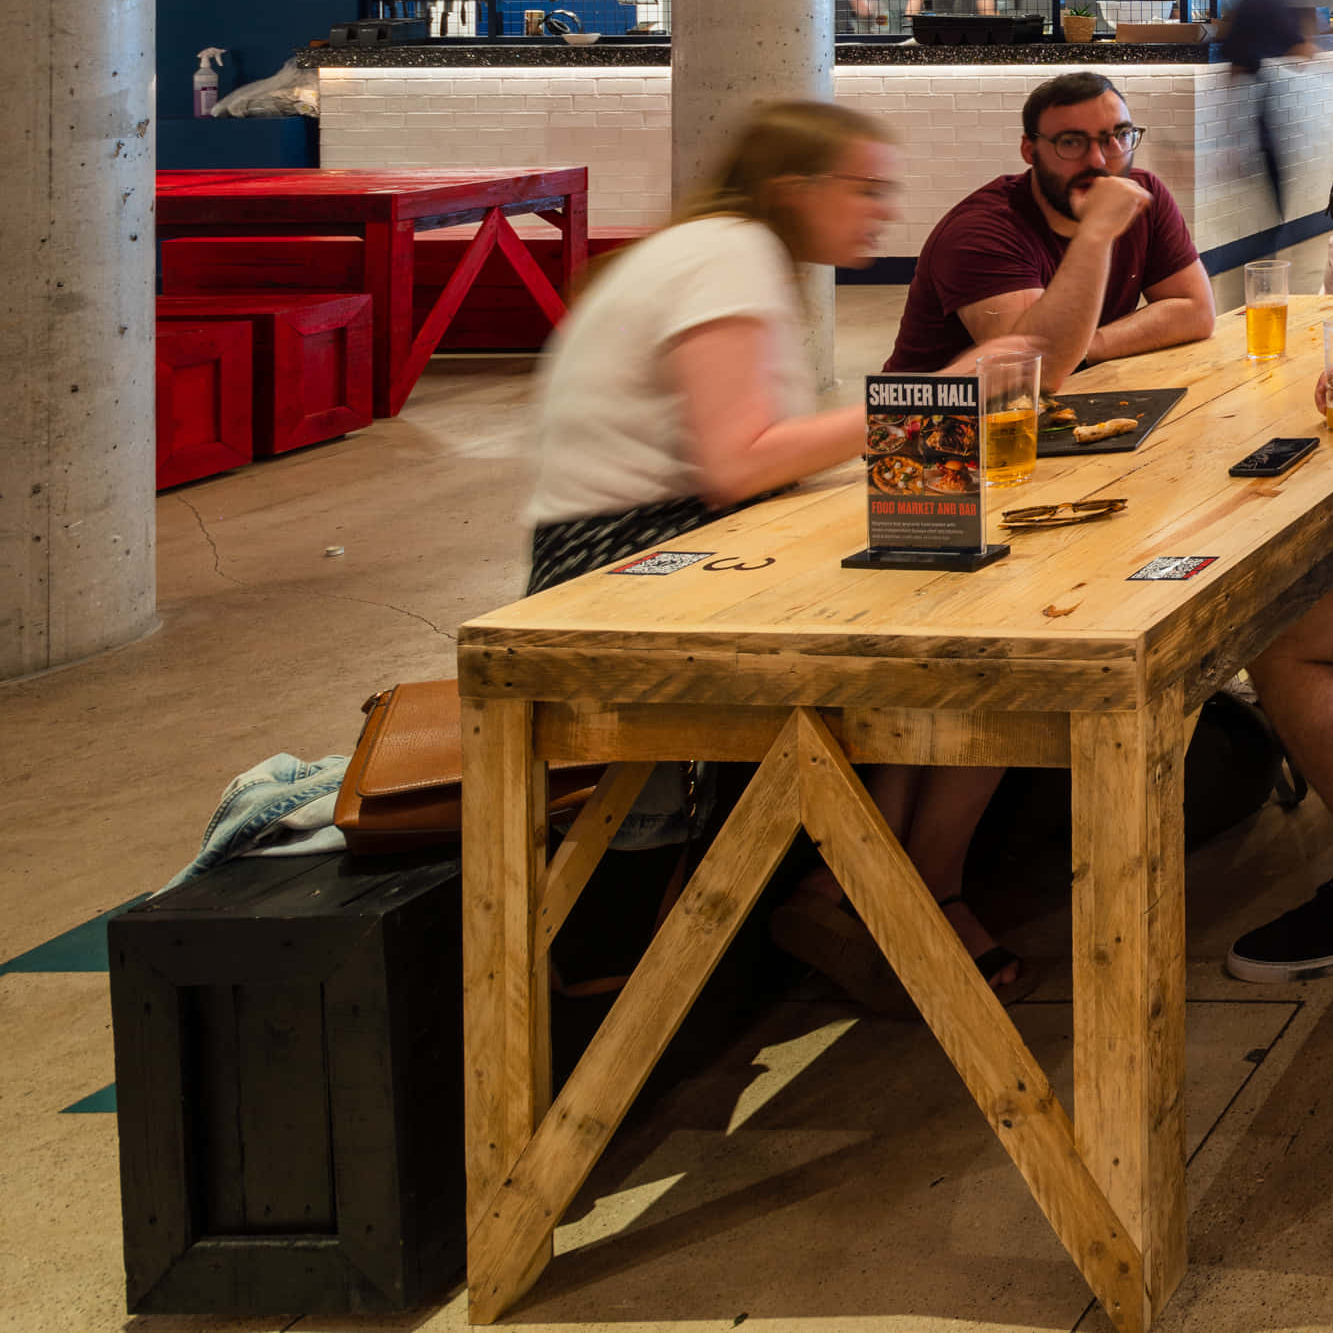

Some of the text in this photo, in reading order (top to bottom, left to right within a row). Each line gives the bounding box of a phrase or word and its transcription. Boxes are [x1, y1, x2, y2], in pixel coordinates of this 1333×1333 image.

[869, 383, 976, 407] SHELTER HALL
[872, 501, 976, 516] FOOD MARKET AND BAR
